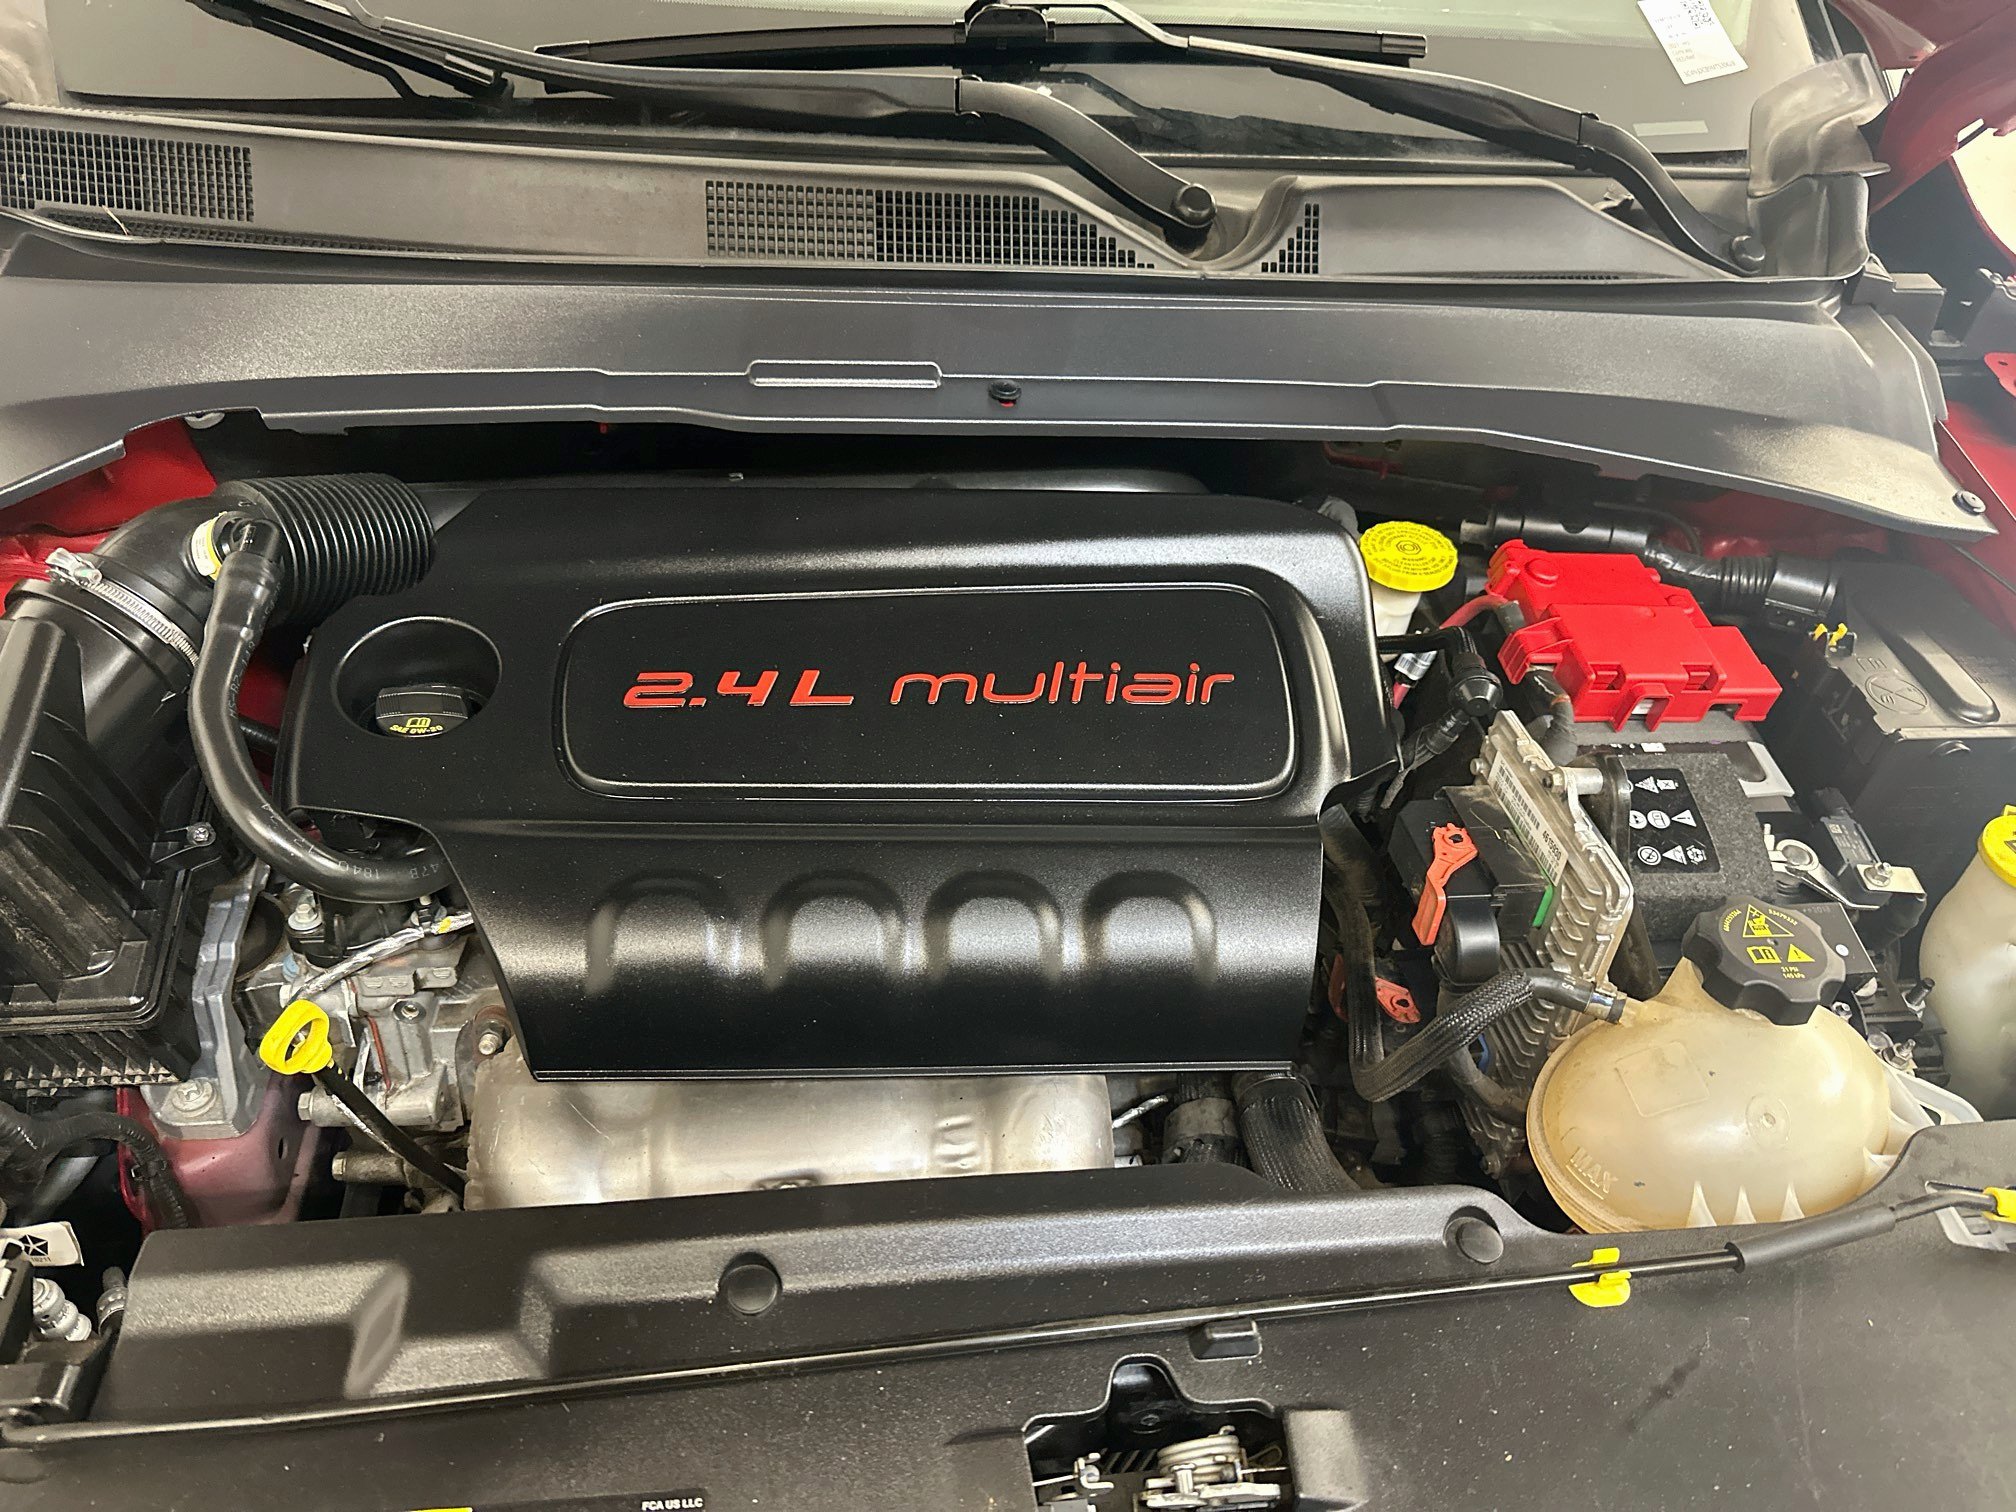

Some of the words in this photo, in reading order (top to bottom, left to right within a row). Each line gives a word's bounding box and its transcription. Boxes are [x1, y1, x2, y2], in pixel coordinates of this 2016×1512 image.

[889, 661, 1235, 705] multiair
[389, 724, 409, 734] SAE
[409, 725, 443, 734] 0W-20
[1542, 830, 1562, 861] 4615930
[1569, 1146, 1619, 1193] MAX
[641, 1501, 664, 1510] FCA
[664, 1499, 680, 1509] US
[682, 1498, 703, 1508] LLC
